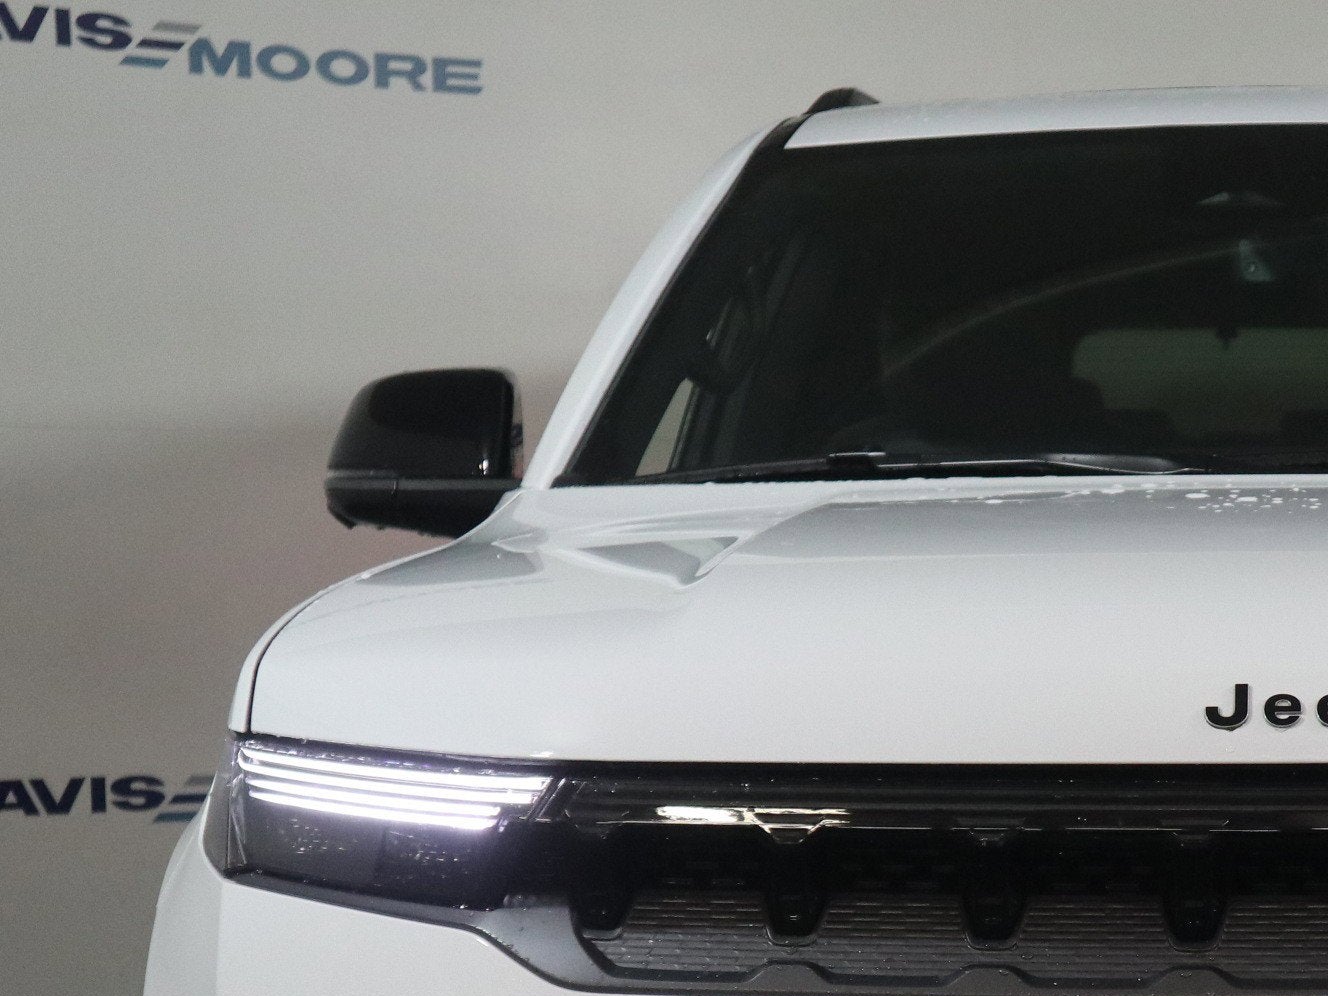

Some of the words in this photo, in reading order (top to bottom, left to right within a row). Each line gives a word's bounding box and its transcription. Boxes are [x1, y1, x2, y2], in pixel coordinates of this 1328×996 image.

[0, 2, 133, 51] VIS
[187, 38, 484, 95] MOORE
[0, 775, 166, 817] AVIS
